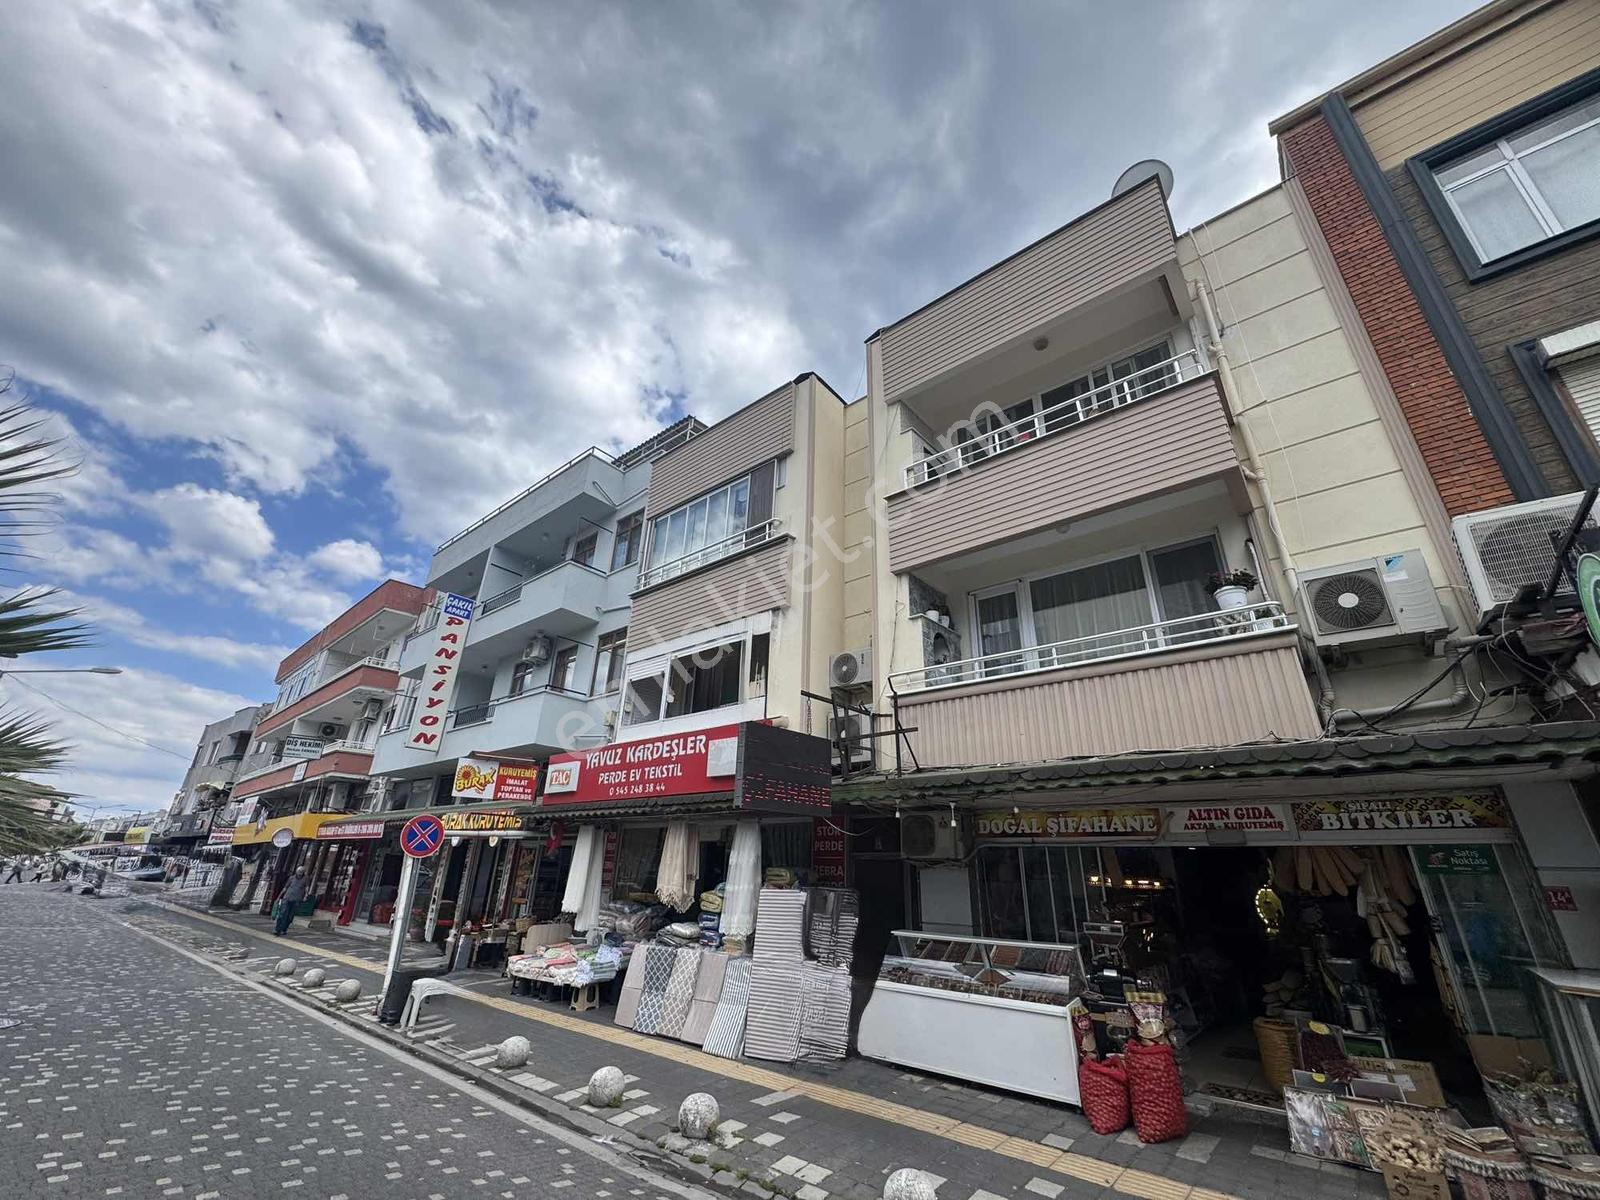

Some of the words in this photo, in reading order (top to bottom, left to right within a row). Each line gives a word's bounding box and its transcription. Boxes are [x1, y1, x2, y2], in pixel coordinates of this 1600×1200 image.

[446, 606, 469, 617] APART
[586, 748, 623, 769] YAVUZ
[626, 735, 707, 763] KARDEŞLER
[456, 768, 497, 791] BURAK
[598, 769, 626, 785] PERDE
[629, 768, 641, 782] EV
[644, 763, 682, 779] TEKSTİL
[497, 791, 532, 800] PERAKENDE
[500, 785, 524, 793] TOPTAN
[609, 787, 614, 796] 0
[616, 785, 628, 795] 545
[630, 784, 643, 793] 248
[644, 783, 654, 793] 38
[656, 782, 665, 791] 44
[1187, 807, 1231, 821] ALTIN
[1233, 806, 1276, 820] GIDA
[978, 815, 1043, 834] DOĞAL
[1046, 813, 1157, 838] ŞİFAHANE
[814, 840, 844, 851] PERDE
